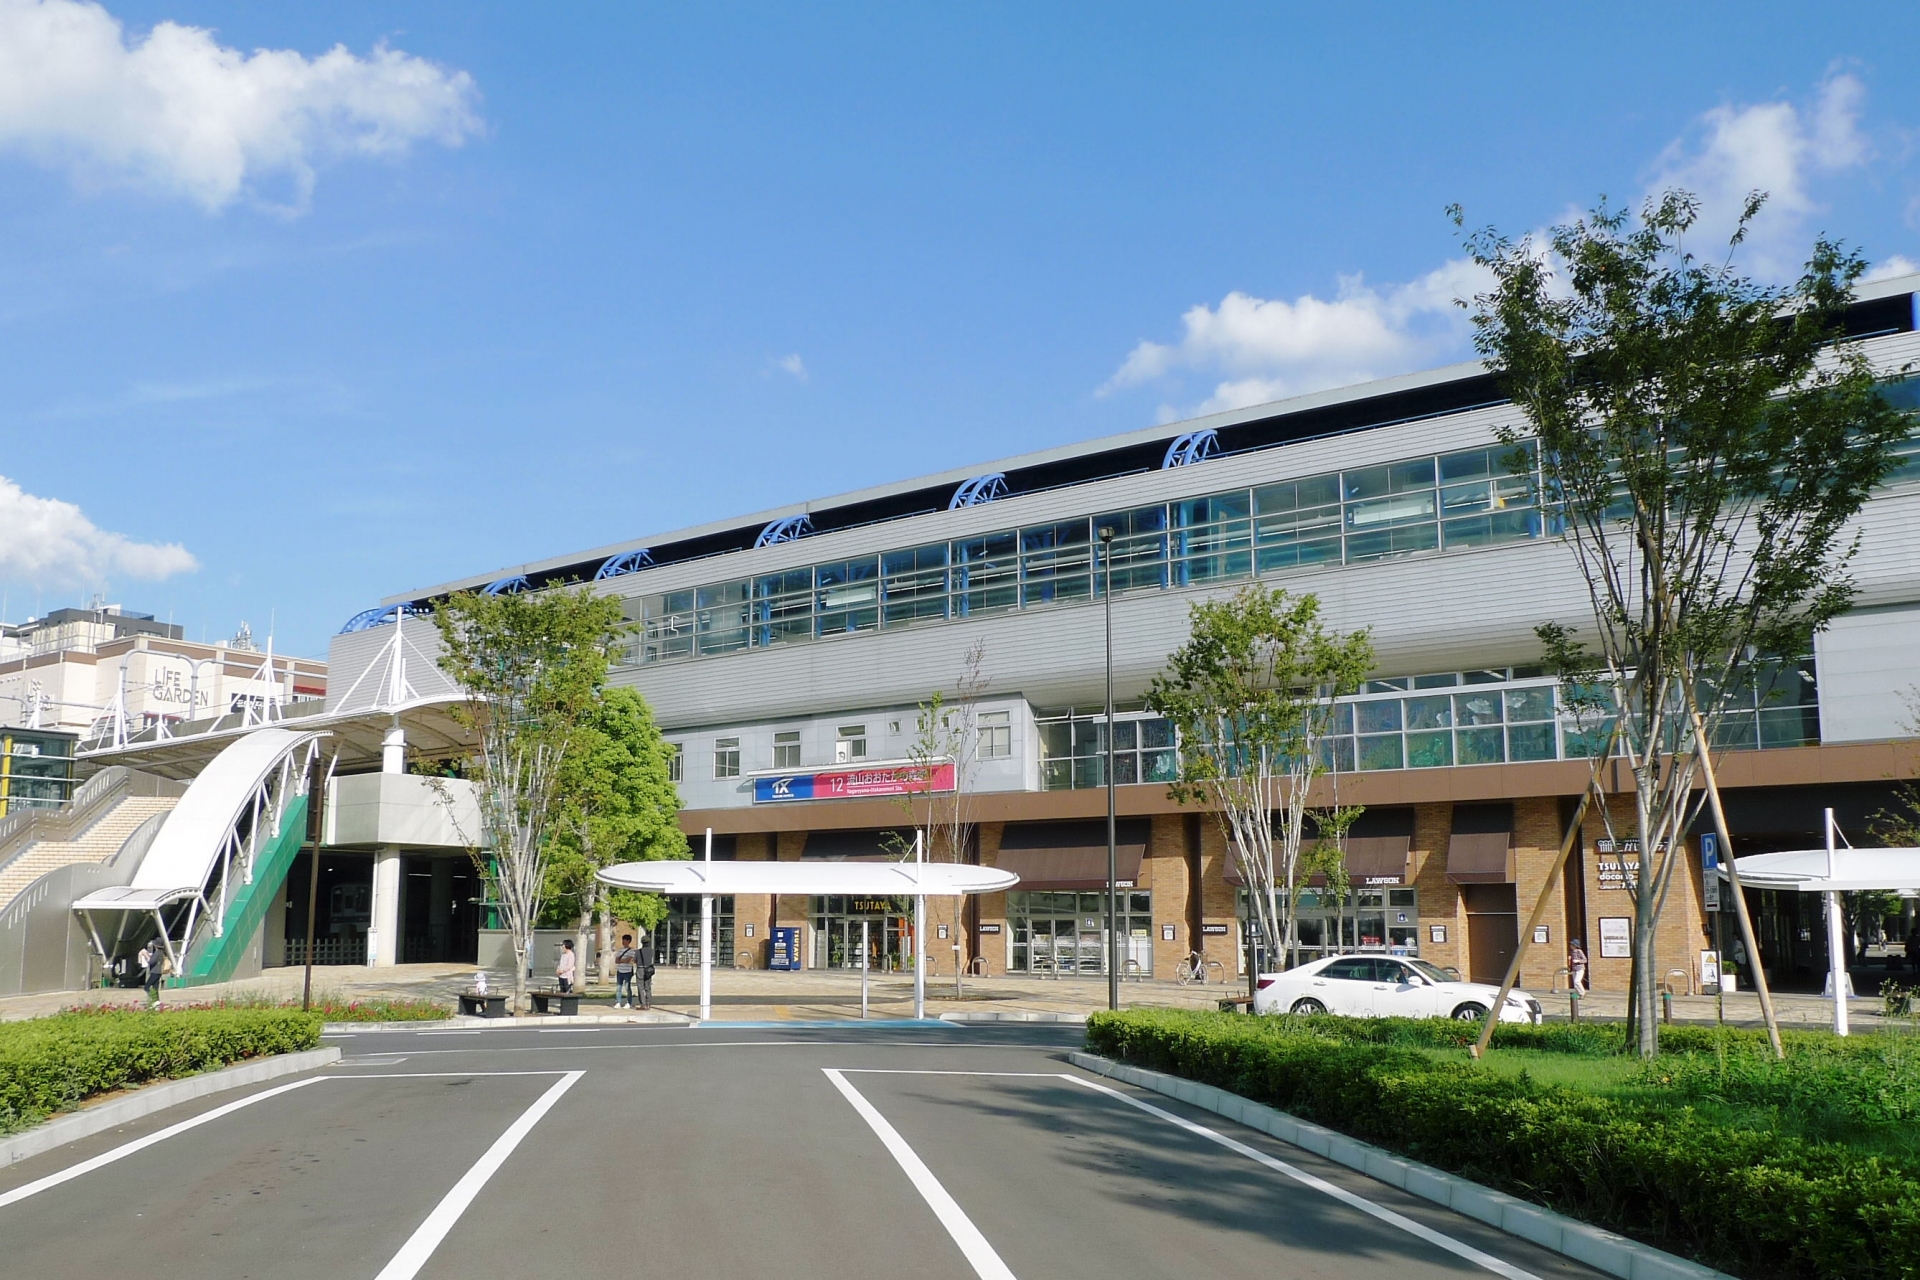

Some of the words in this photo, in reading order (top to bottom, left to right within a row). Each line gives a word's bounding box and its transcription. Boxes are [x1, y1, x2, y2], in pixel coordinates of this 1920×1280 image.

[155, 666, 181, 687] LIFE
[153, 685, 209, 706] GARDEN
[831, 777, 843, 793] 12
[1365, 877, 1400, 885] LAWSON
[854, 901, 892, 911] TSUTAYA
